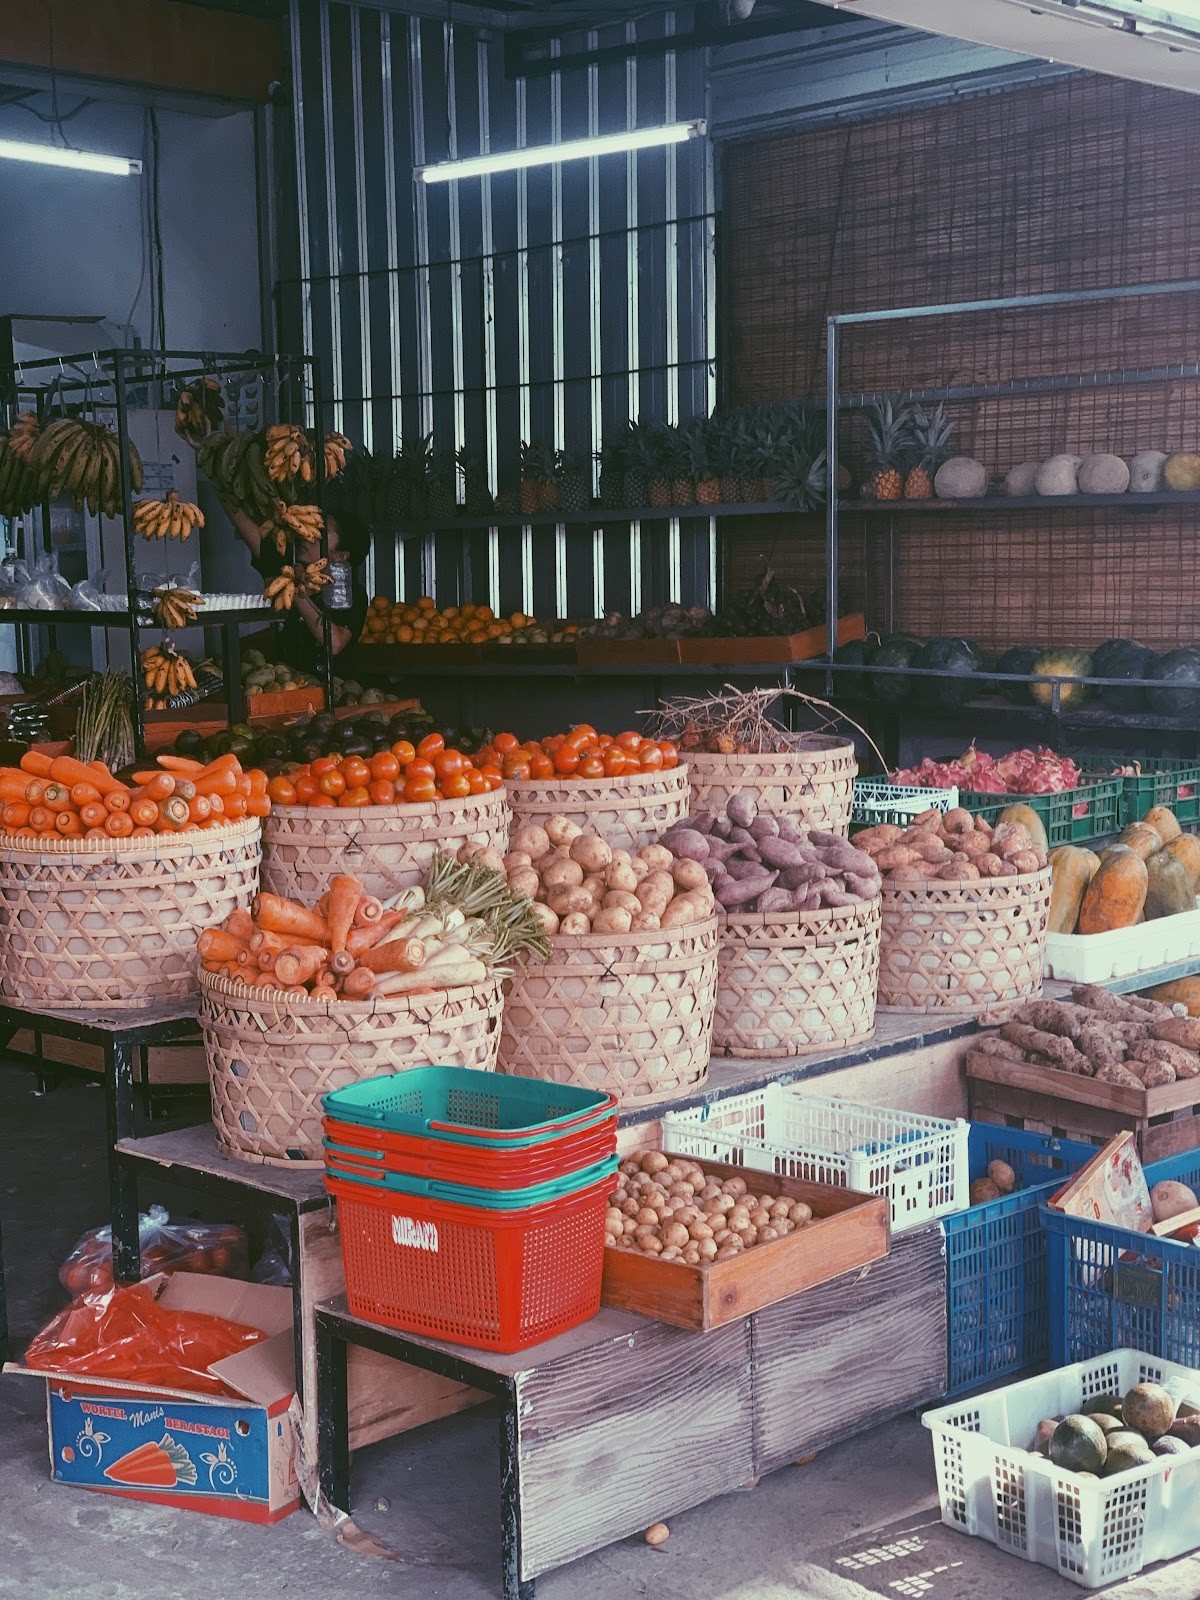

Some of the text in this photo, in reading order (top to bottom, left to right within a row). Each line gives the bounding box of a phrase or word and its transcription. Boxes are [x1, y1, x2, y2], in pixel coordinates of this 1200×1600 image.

[80, 1402, 230, 1440] WORTEL Manis BERASTAGI
